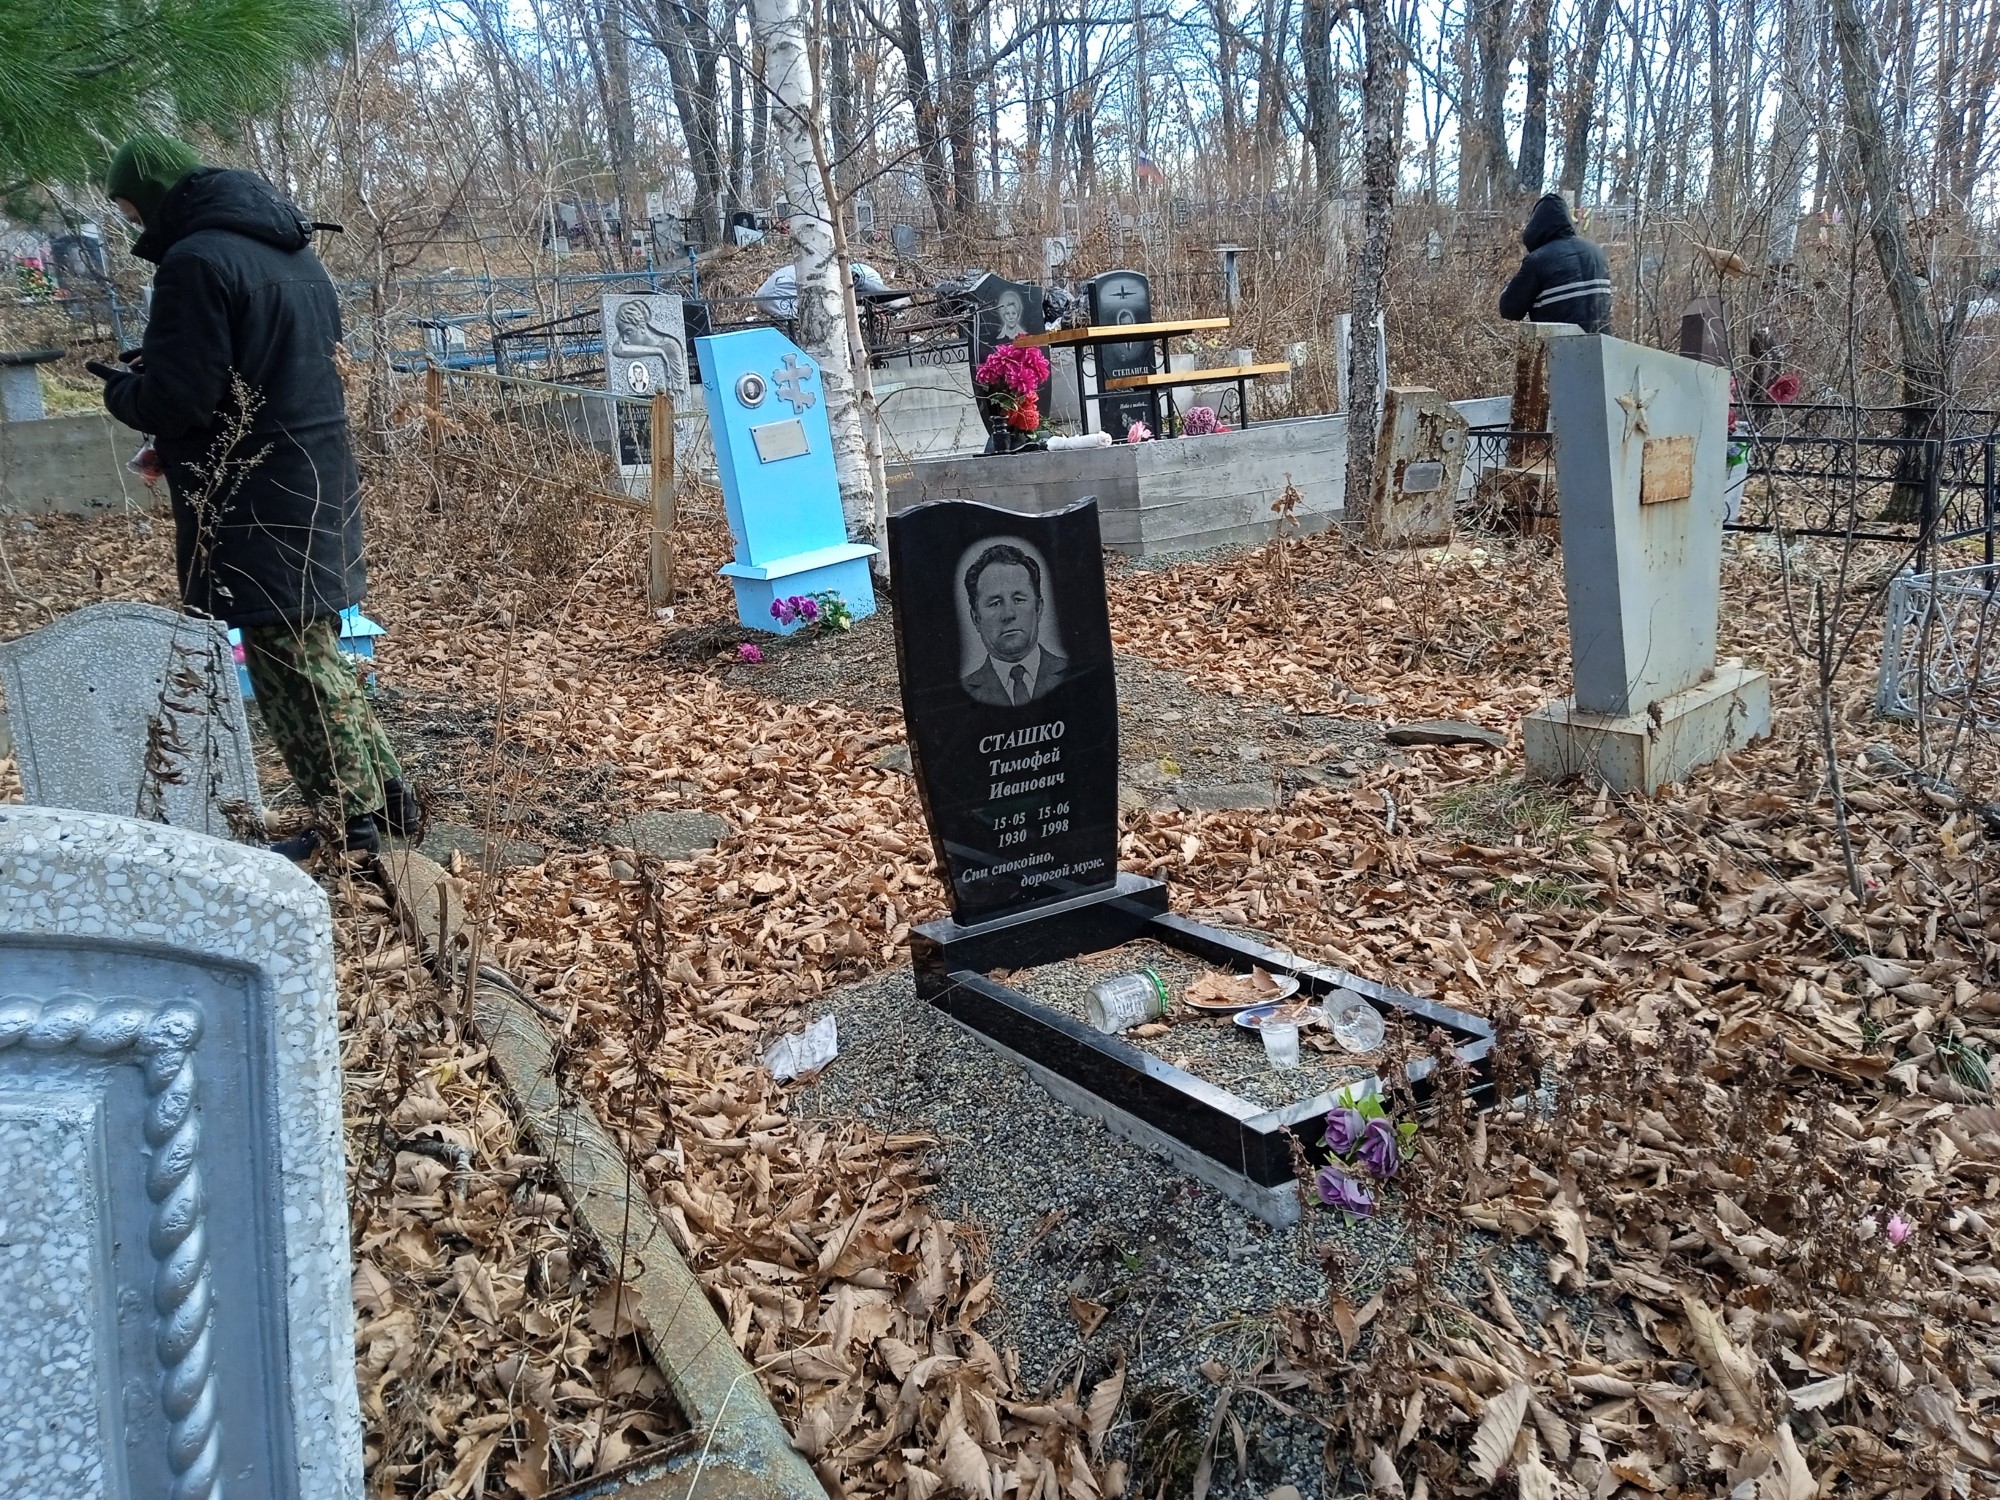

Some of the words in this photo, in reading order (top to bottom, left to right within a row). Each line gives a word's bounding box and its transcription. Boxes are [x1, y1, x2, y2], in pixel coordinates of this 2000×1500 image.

[979, 720, 1065, 753] СТАШКО
[989, 747, 1061, 776] Тимофей
[988, 772, 1065, 800] Иванович
[998, 829, 1027, 848] 1930
[1040, 819, 1069, 838] 1998
[962, 866, 989, 884] Спи
[992, 852, 1054, 876] спокойно,
[1020, 865, 1070, 887] дорогой
[1072, 858, 1105, 875] муж.
